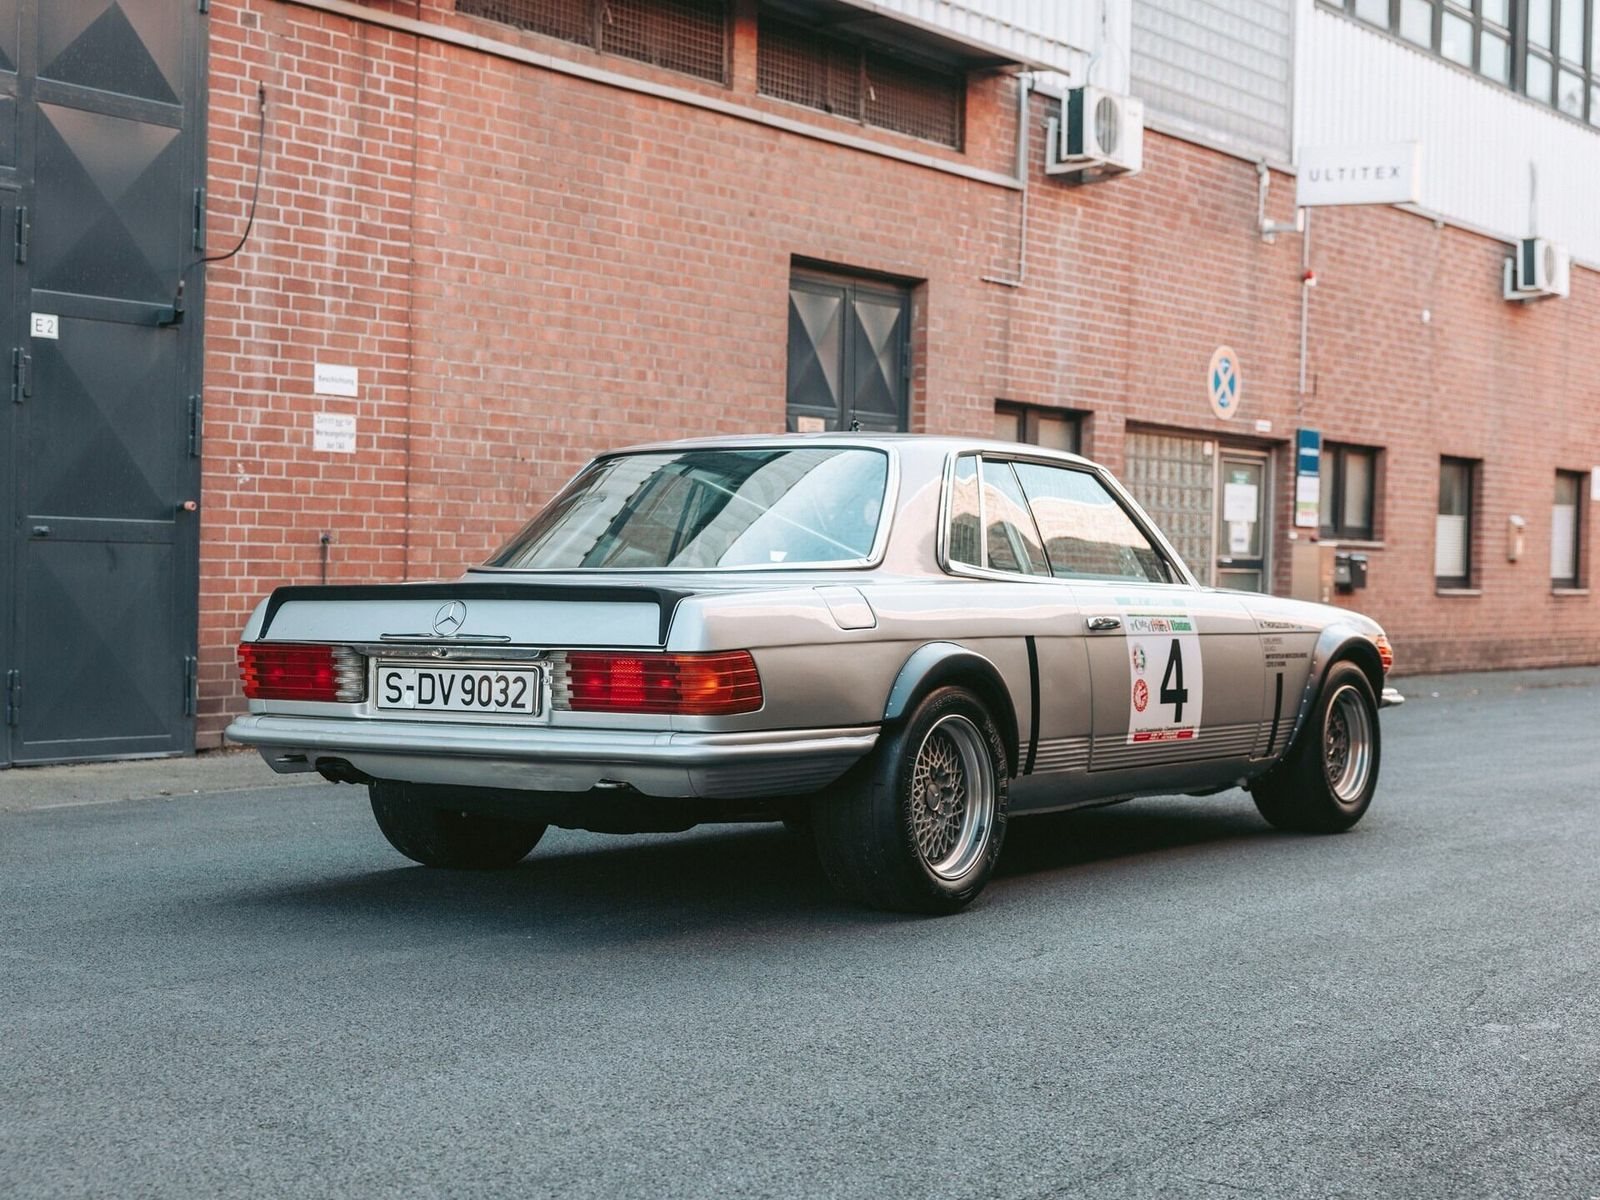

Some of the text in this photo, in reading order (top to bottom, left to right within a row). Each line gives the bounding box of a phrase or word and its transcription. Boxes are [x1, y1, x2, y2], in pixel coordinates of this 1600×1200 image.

[1309, 167, 1400, 182] ULTITEX
[36, 318, 53, 334] E 2
[385, 671, 527, 708] S-DV 9032
[1160, 638, 1188, 723] 4
